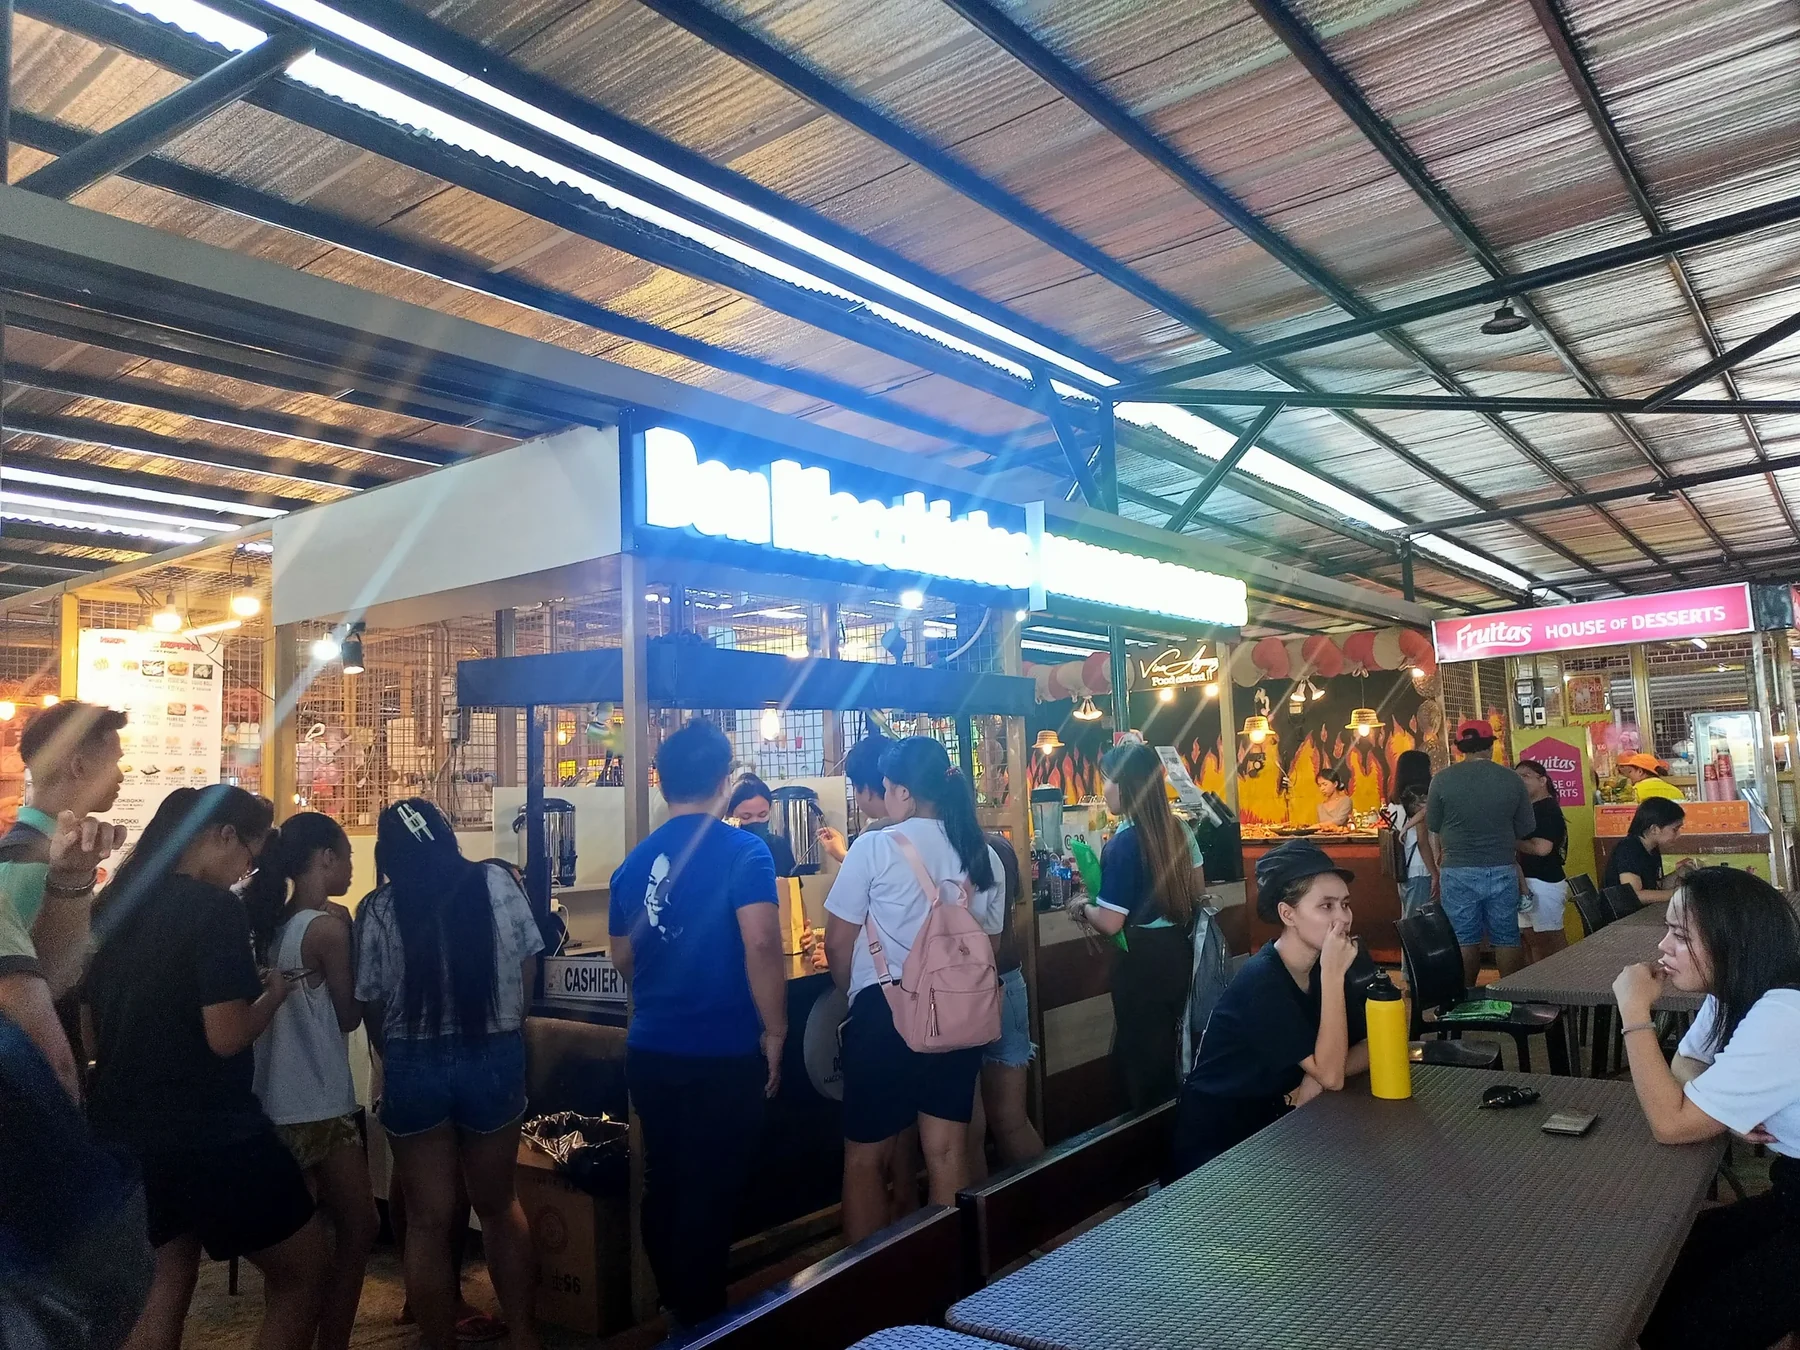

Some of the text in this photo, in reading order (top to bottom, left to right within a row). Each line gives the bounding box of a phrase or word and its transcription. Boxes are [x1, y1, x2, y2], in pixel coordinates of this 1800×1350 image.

[1456, 605, 1726, 653] Fruitas HOUSE OF DESSERTS
[1565, 780, 1577, 788] OF
[565, 967, 618, 994] CASHIER
